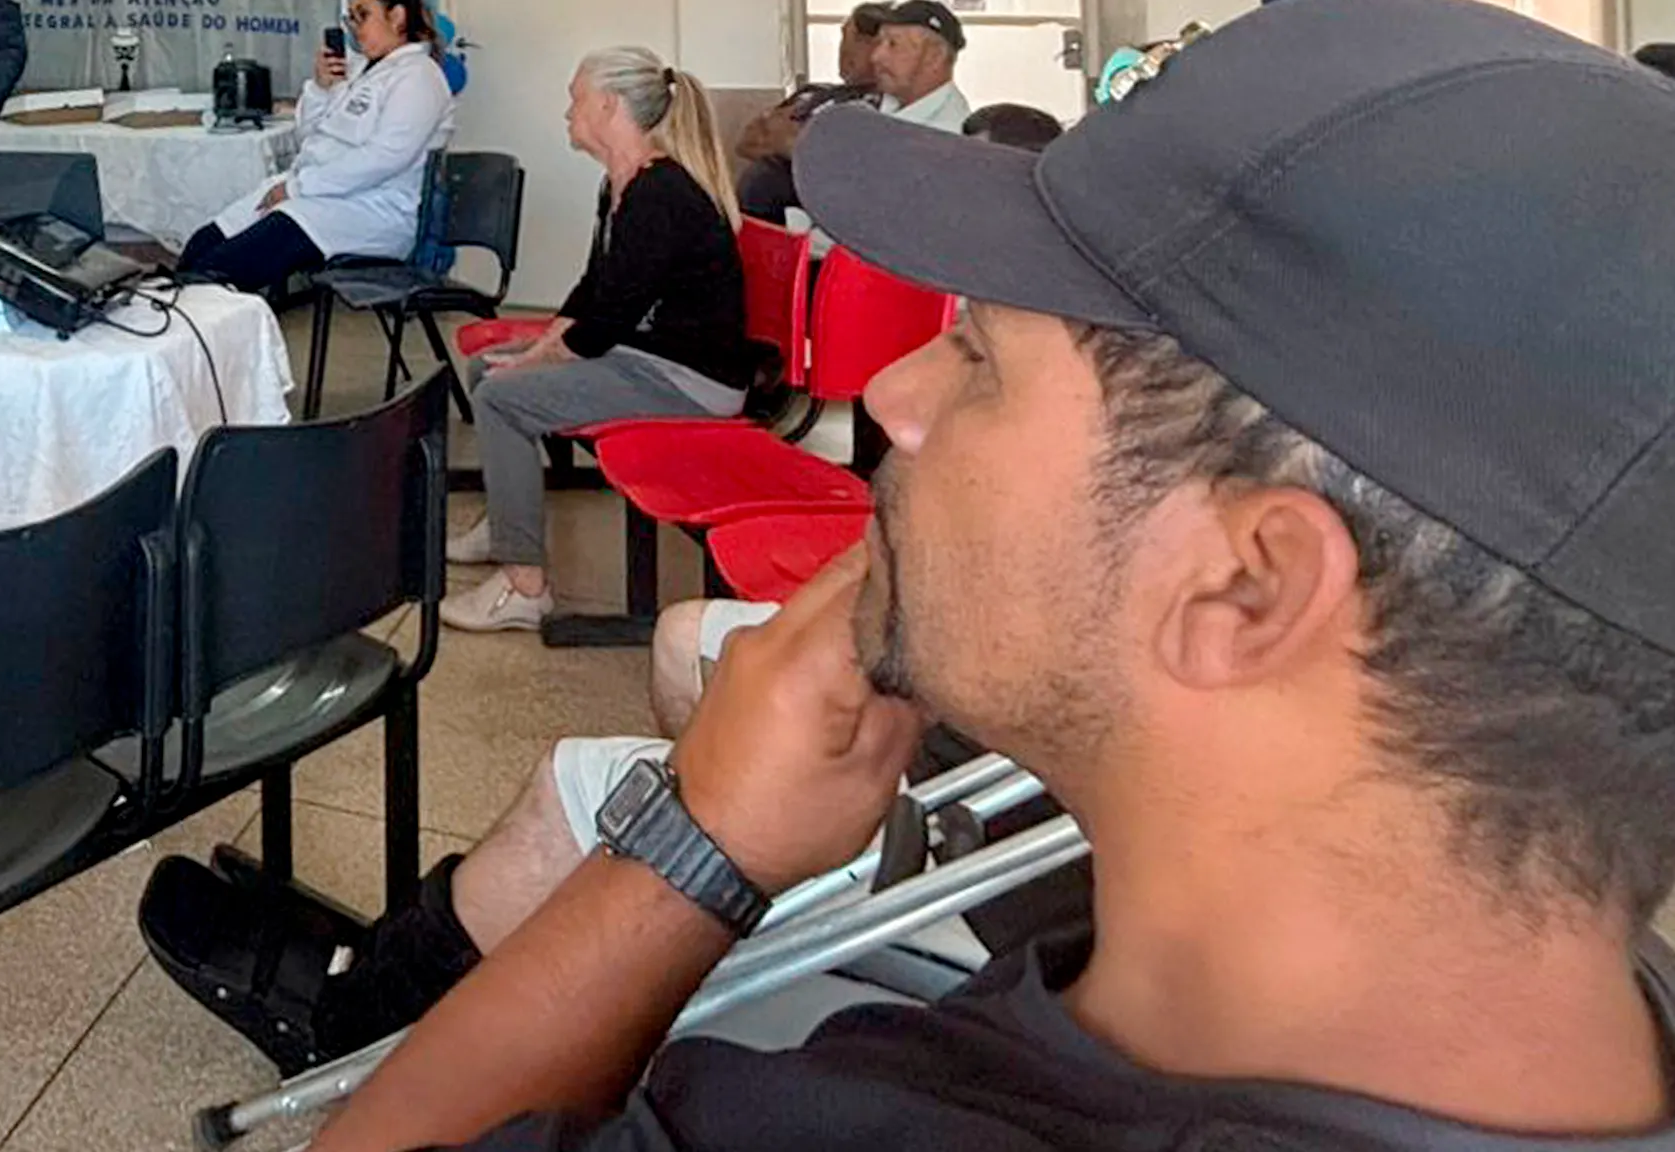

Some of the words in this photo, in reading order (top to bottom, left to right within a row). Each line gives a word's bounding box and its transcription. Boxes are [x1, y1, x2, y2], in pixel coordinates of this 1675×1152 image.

[127, 9, 191, 27] SAÚDE
[202, 14, 227, 30] DO
[236, 16, 300, 35] HOMEM
